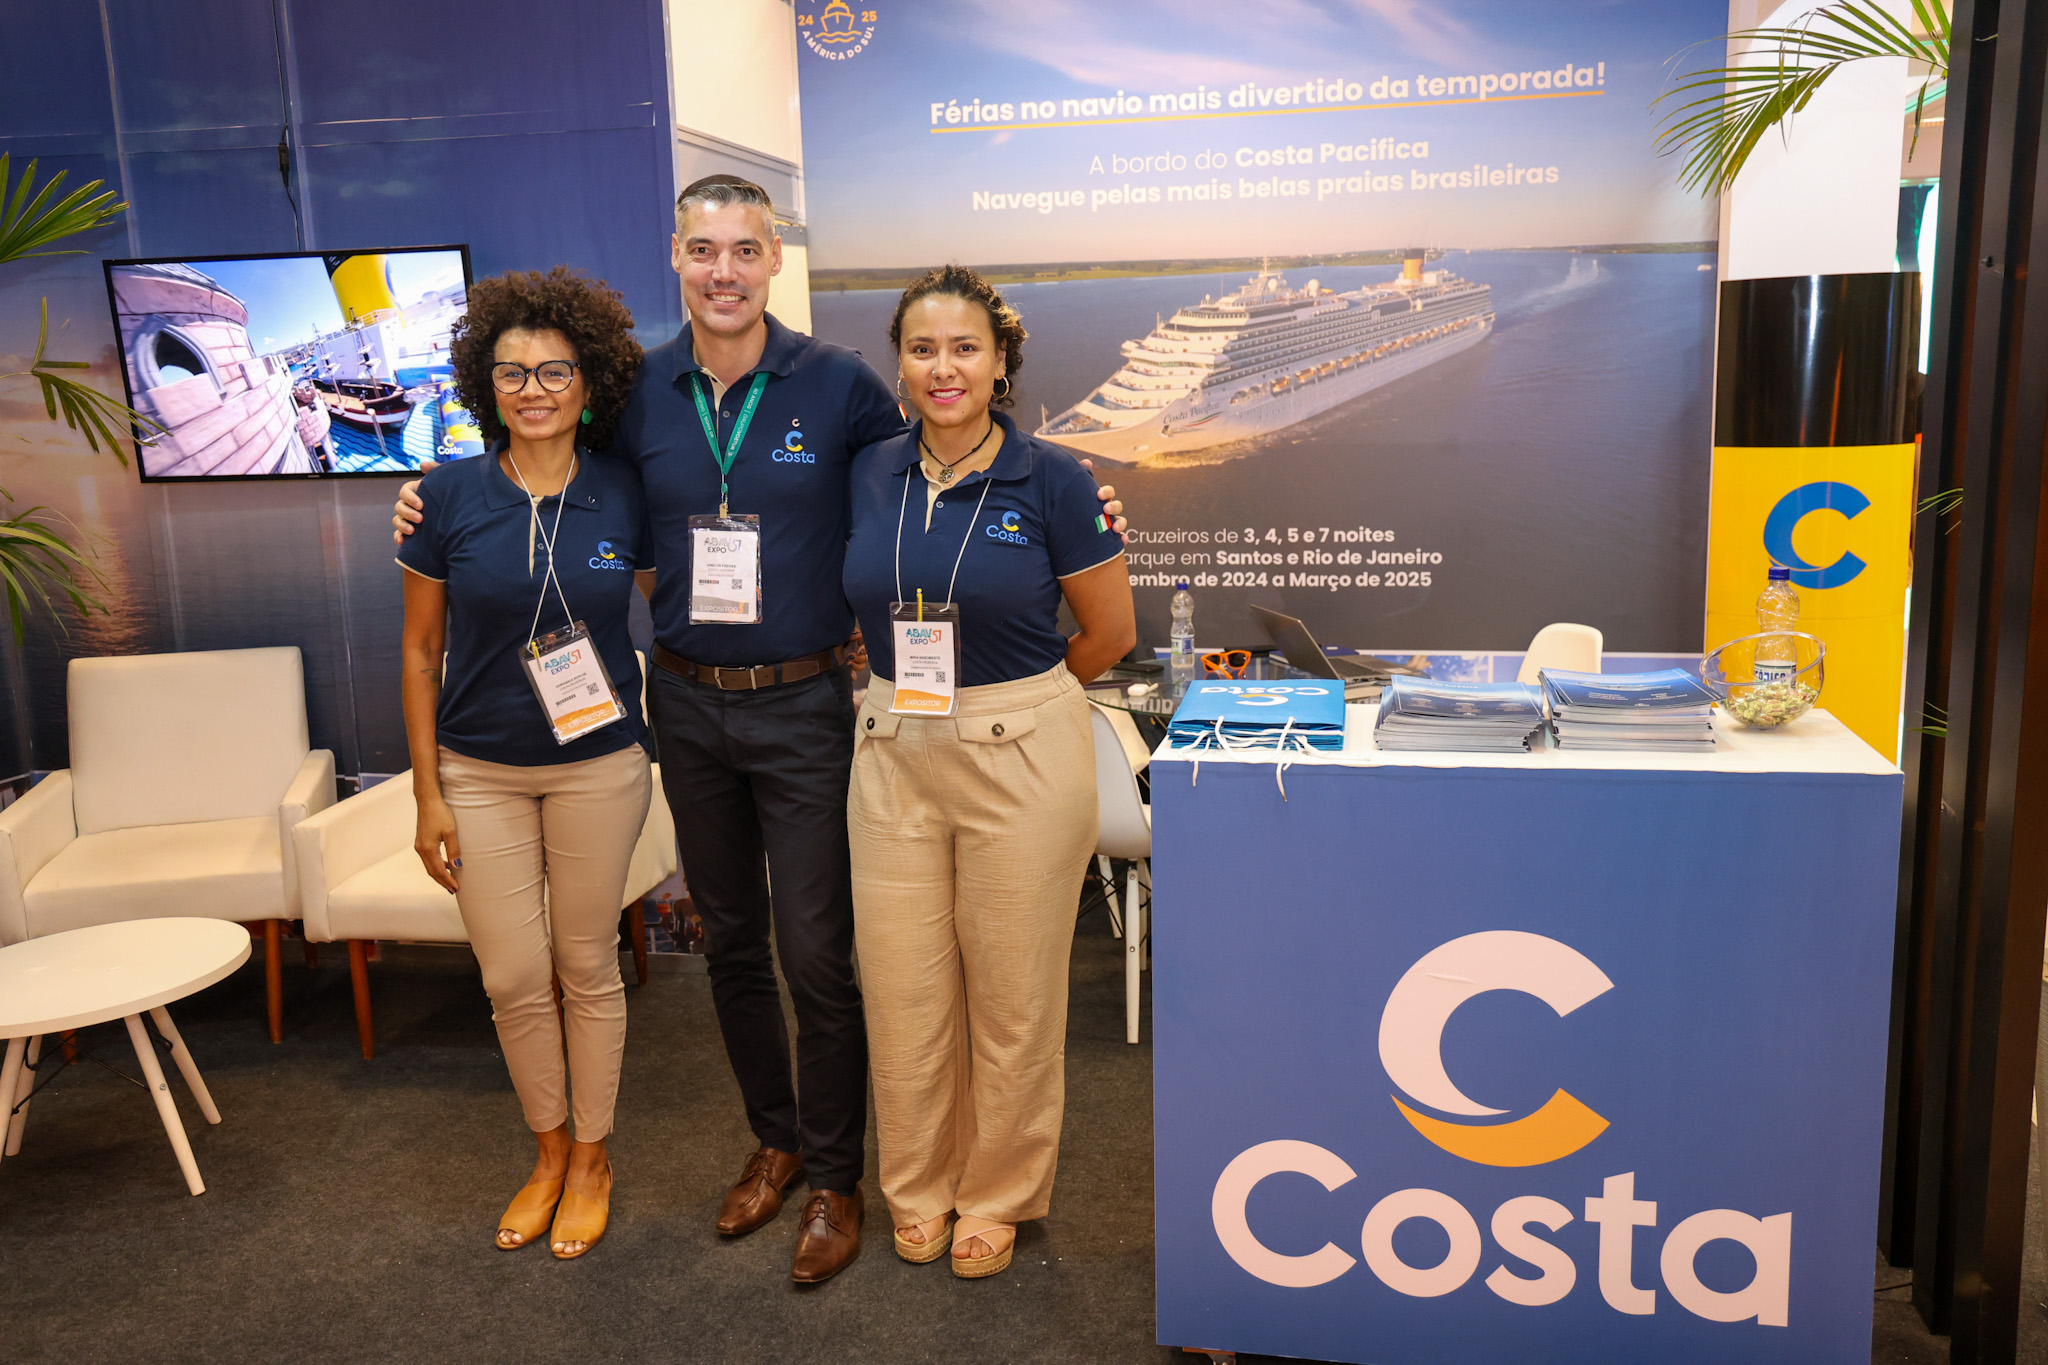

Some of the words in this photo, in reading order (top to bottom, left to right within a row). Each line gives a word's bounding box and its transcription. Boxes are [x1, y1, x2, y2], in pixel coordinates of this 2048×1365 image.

[798, 14, 814, 26] 24
[861, 10, 877, 22] 25
[802, 31, 845, 60] AMÉRICA
[846, 44, 862, 58] DO
[861, 26, 874, 46] SUL
[930, 98, 1014, 125] Férias
[1021, 100, 1056, 120] no
[1063, 90, 1142, 118] navio
[1149, 86, 1221, 112] mais
[1228, 78, 1363, 108] divertido
[1370, 76, 1408, 100] da
[1416, 62, 1606, 100] temporada!
[1089, 155, 1104, 175] A
[1113, 150, 1187, 174] bordo
[1194, 148, 1228, 170] do
[1235, 144, 1313, 168] Costa
[1320, 137, 1429, 163] Pacifica
[972, 190, 1084, 214] Navegue
[1092, 184, 1160, 211] pelas
[1167, 178, 1232, 202] mais
[1238, 176, 1310, 199] belas
[1318, 170, 1404, 201] praias
[1411, 163, 1560, 191] brasileiras
[747, 394, 756, 410] ANOS
[1164, 411, 1188, 424] Costa
[437, 446, 464, 455] Costa
[772, 449, 816, 464] Costa
[704, 537, 730, 547] ABAV
[986, 525, 1028, 546] Costa
[1127, 528, 1209, 544] Cruzeiros
[1215, 528, 1238, 544] de
[1244, 528, 1260, 546] 3,
[1264, 528, 1282, 546] 4,
[1288, 528, 1299, 543] 5
[1303, 531, 1316, 543] e
[1319, 528, 1330, 543] 7
[1334, 526, 1395, 543] noites
[1124, 552, 1175, 568] arque
[1180, 553, 1210, 566] em
[1216, 550, 1283, 566] Santos
[1288, 552, 1298, 566] e
[1303, 550, 1332, 566] Rio
[1337, 548, 1362, 566] de
[1366, 548, 1442, 566] Janeiro
[1130, 572, 1190, 588] embro
[1194, 572, 1218, 588] de
[1222, 572, 1268, 588] 2024
[1272, 576, 1285, 588] a
[1290, 572, 1351, 592] Março
[1356, 571, 1380, 587] de
[1384, 571, 1432, 587] 2025
[906, 628, 932, 638] ABAV
[929, 630, 942, 643] 51
[544, 652, 571, 671] ABAV
[550, 663, 570, 675] EXPO
[1200, 686, 1330, 696] Costa
[568, 709, 606, 728] EXPOSITOR
[1212, 1139, 1792, 1327] Costa
